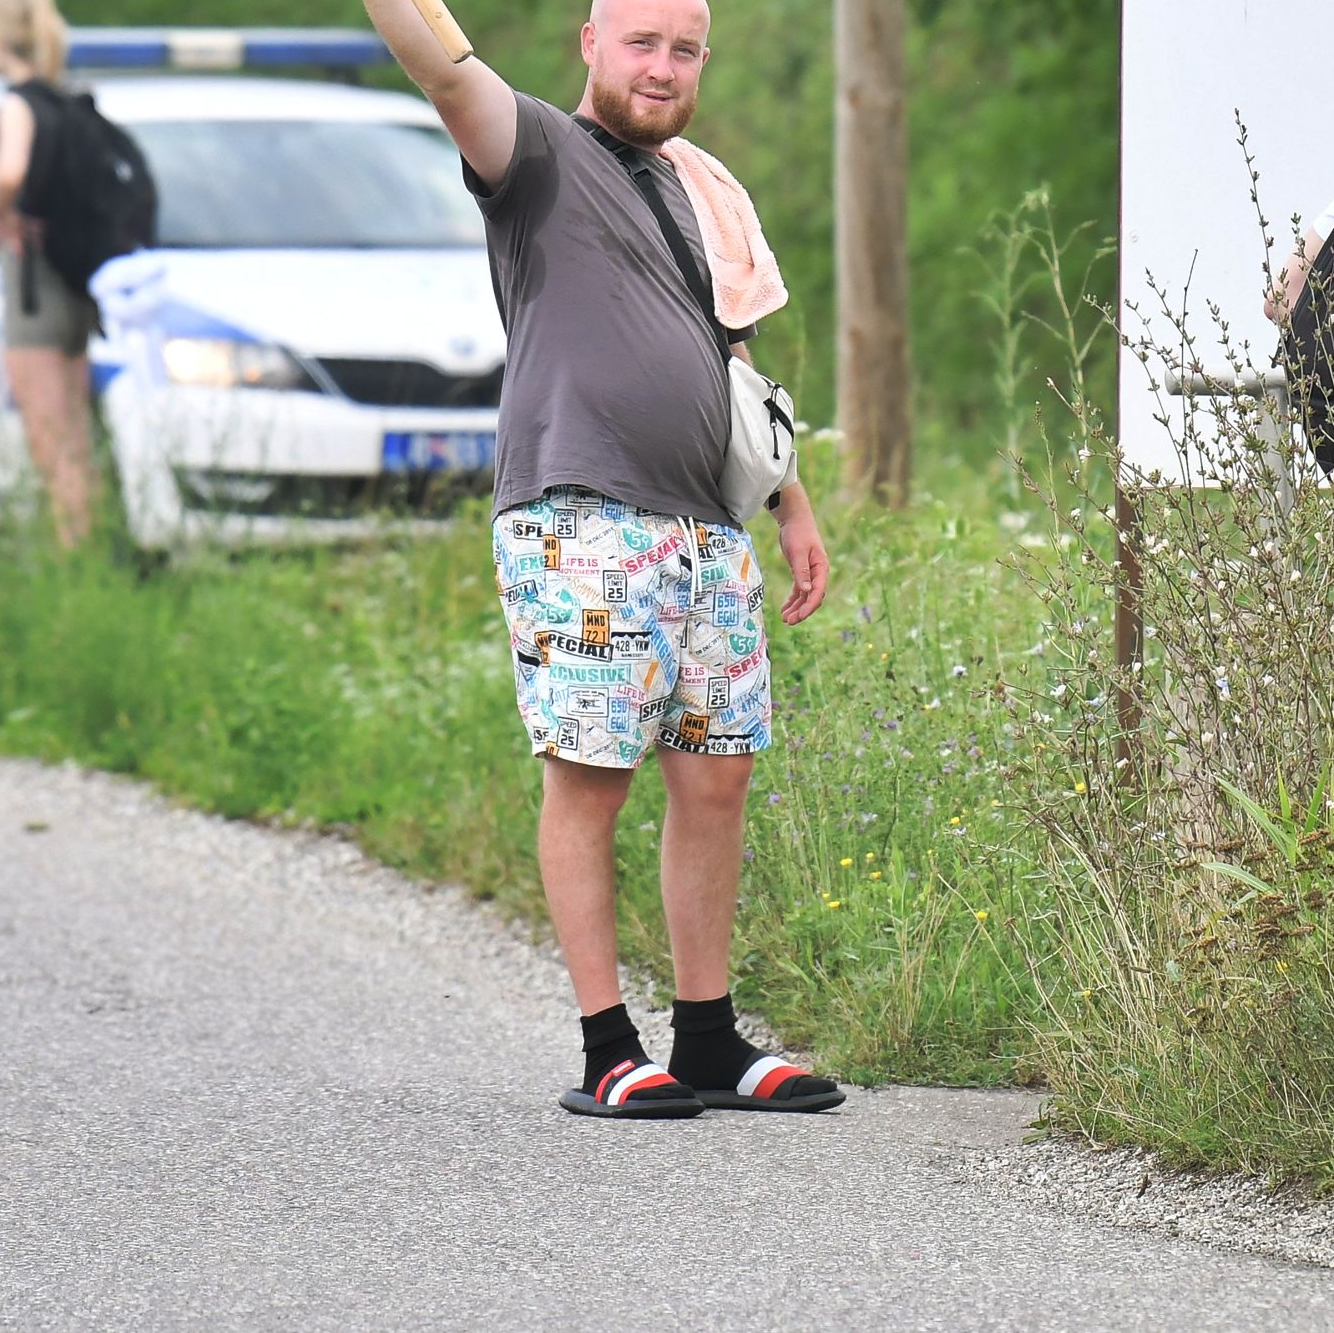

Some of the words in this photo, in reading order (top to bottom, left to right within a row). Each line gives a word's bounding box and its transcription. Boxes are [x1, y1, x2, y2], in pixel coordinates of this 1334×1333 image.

[557, 524, 572, 535] 25
[587, 558, 599, 567] IS
[608, 588, 623, 598] 25
[586, 614, 605, 626] MND
[711, 695, 726, 706] 25
[561, 734, 574, 746] 25
